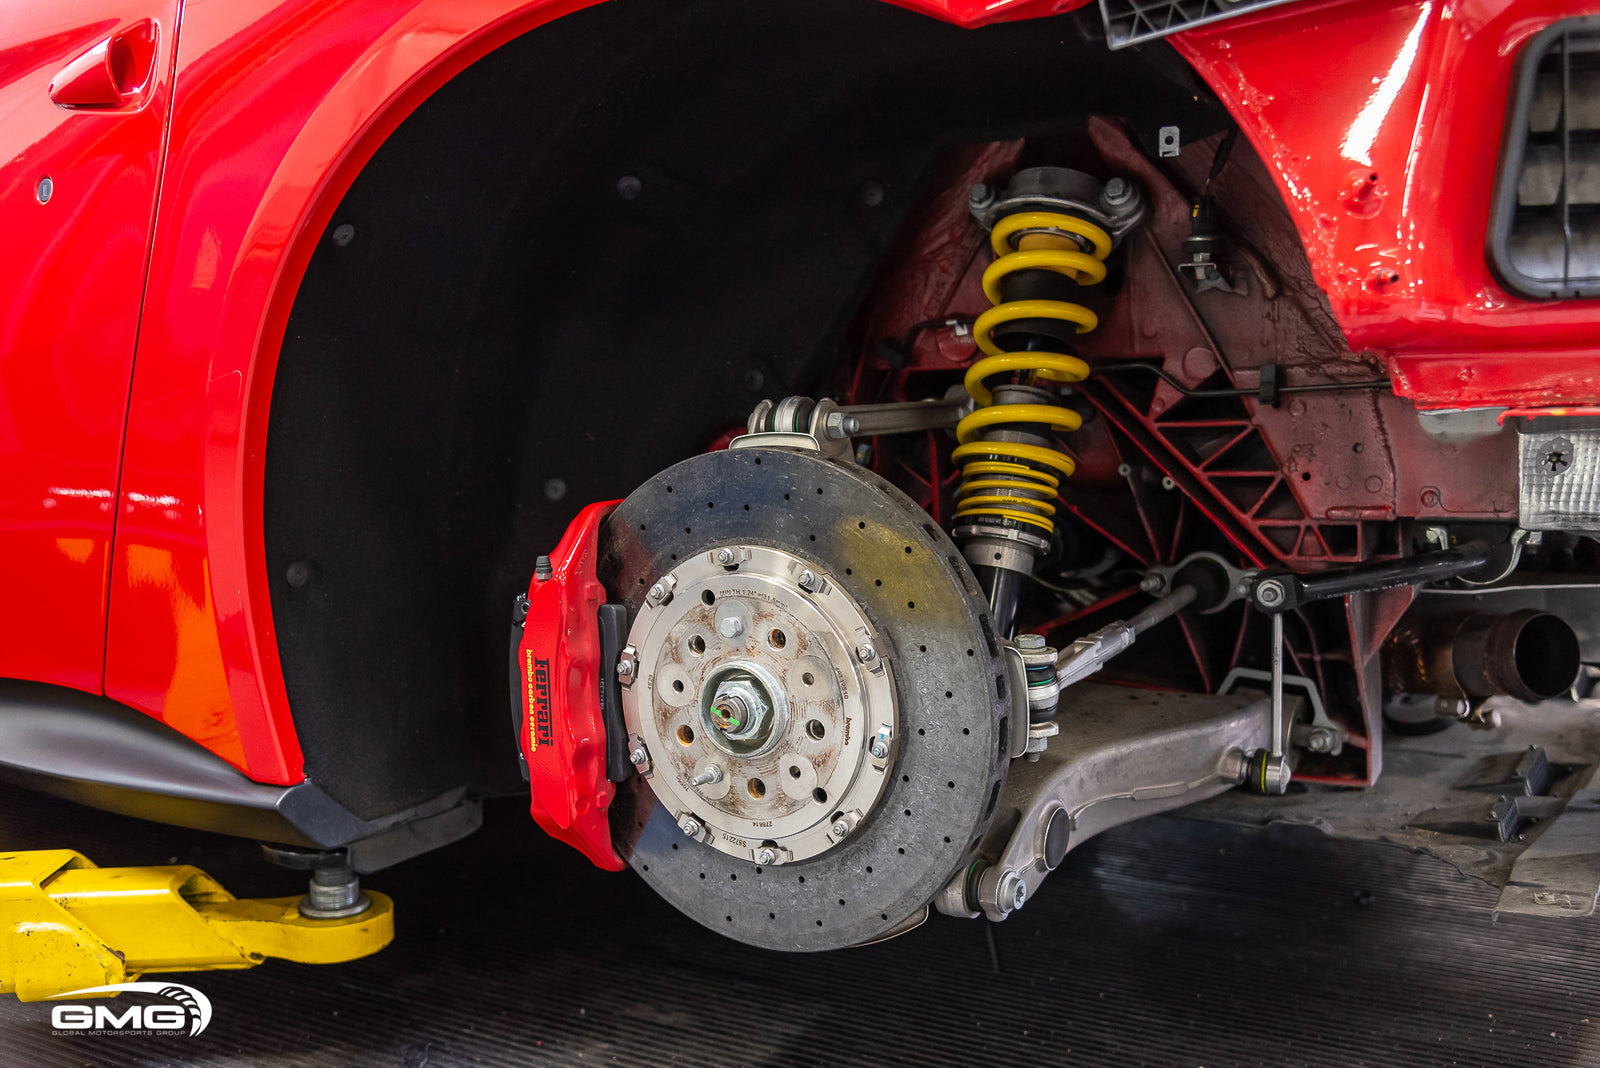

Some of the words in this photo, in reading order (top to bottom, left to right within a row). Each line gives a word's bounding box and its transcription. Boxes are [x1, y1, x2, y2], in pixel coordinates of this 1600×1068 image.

[526, 649, 534, 682] brembo
[534, 657, 553, 747] Ferrari
[529, 716, 538, 752] ceramic
[844, 716, 853, 746] brembo
